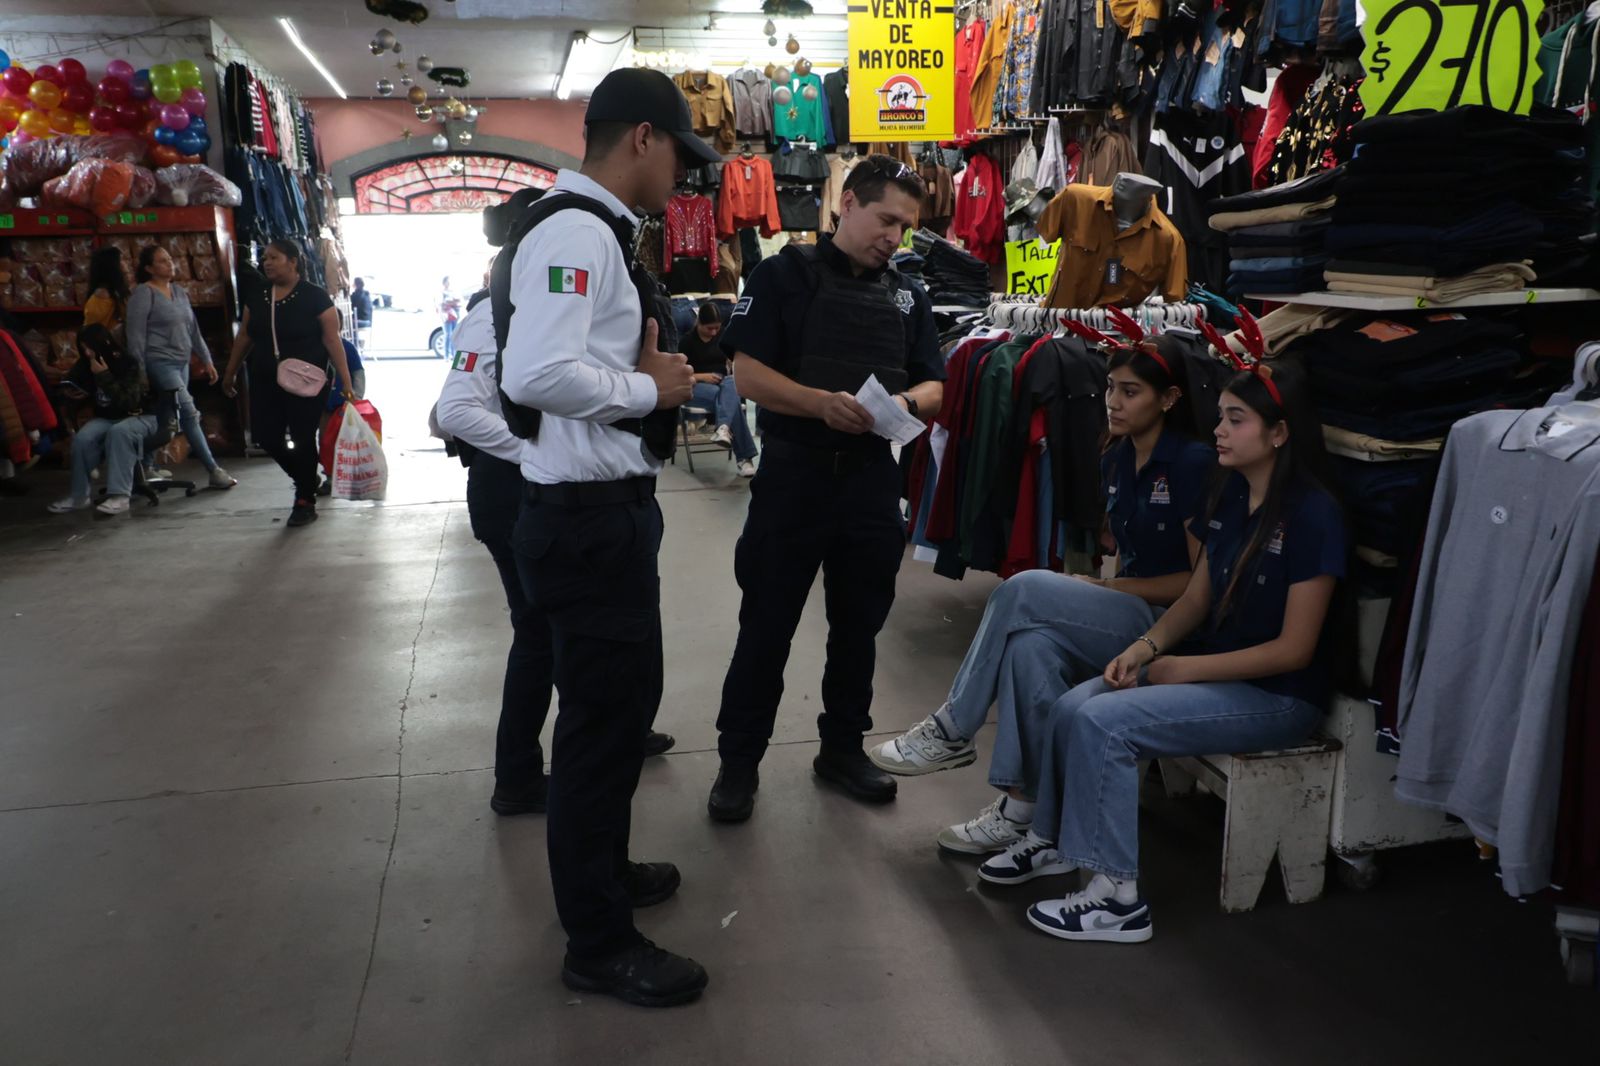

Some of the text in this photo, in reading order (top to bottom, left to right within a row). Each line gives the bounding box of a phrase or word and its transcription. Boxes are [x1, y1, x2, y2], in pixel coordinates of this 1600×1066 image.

[871, 0, 931, 19] VENTA
[889, 24, 913, 44] DE
[858, 49, 944, 69] MAYOREO
